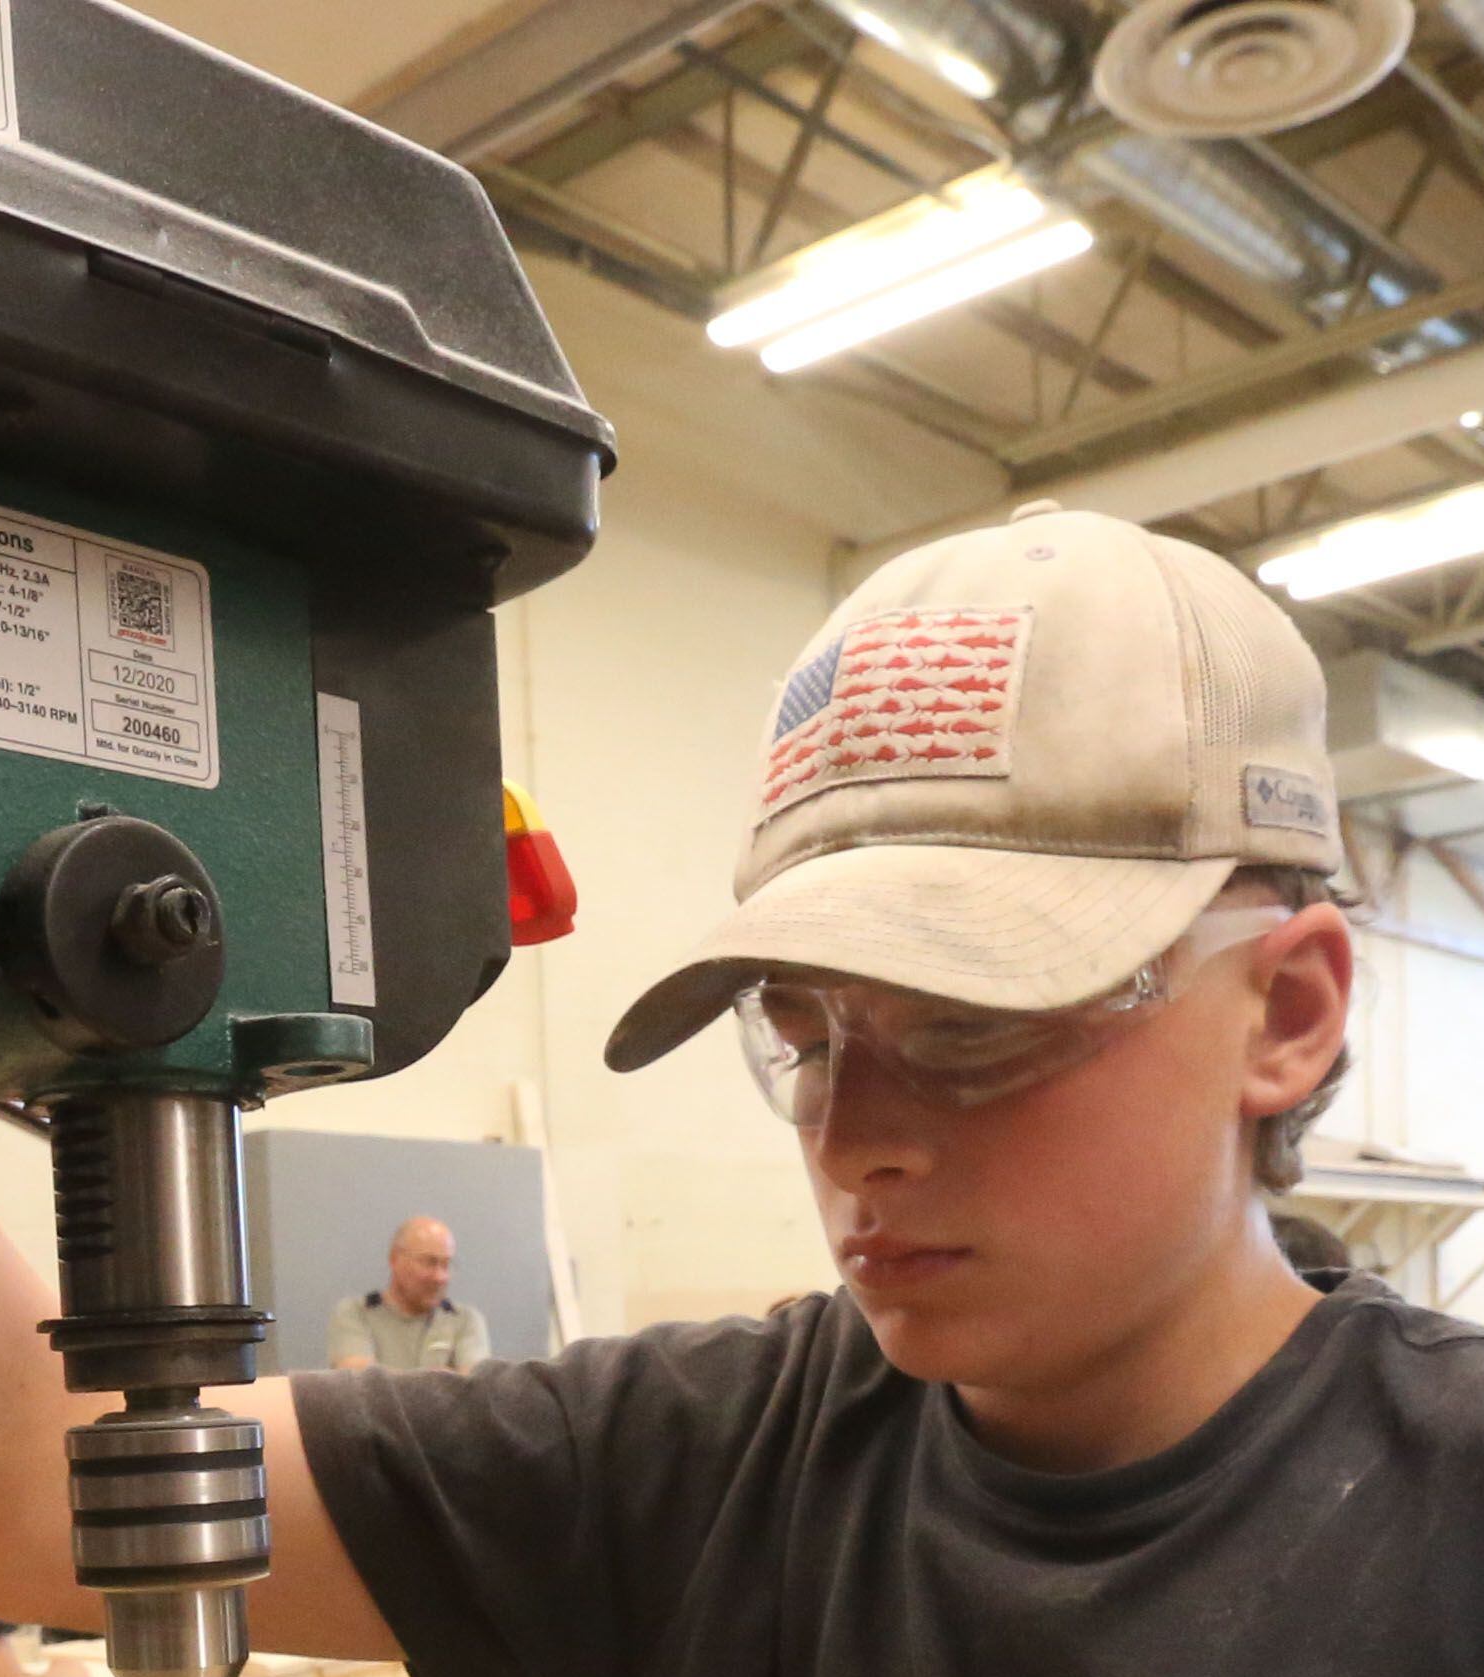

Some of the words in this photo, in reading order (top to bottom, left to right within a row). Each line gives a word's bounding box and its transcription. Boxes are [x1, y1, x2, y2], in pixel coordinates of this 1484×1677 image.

[22, 569, 50, 586] 2.3A
[9, 583, 44, 602] 4-1/8"
[113, 665, 175, 694] 12/2020
[17, 682, 41, 698] 1/2"
[50, 708, 78, 724] RPM
[122, 716, 181, 744] 200460
